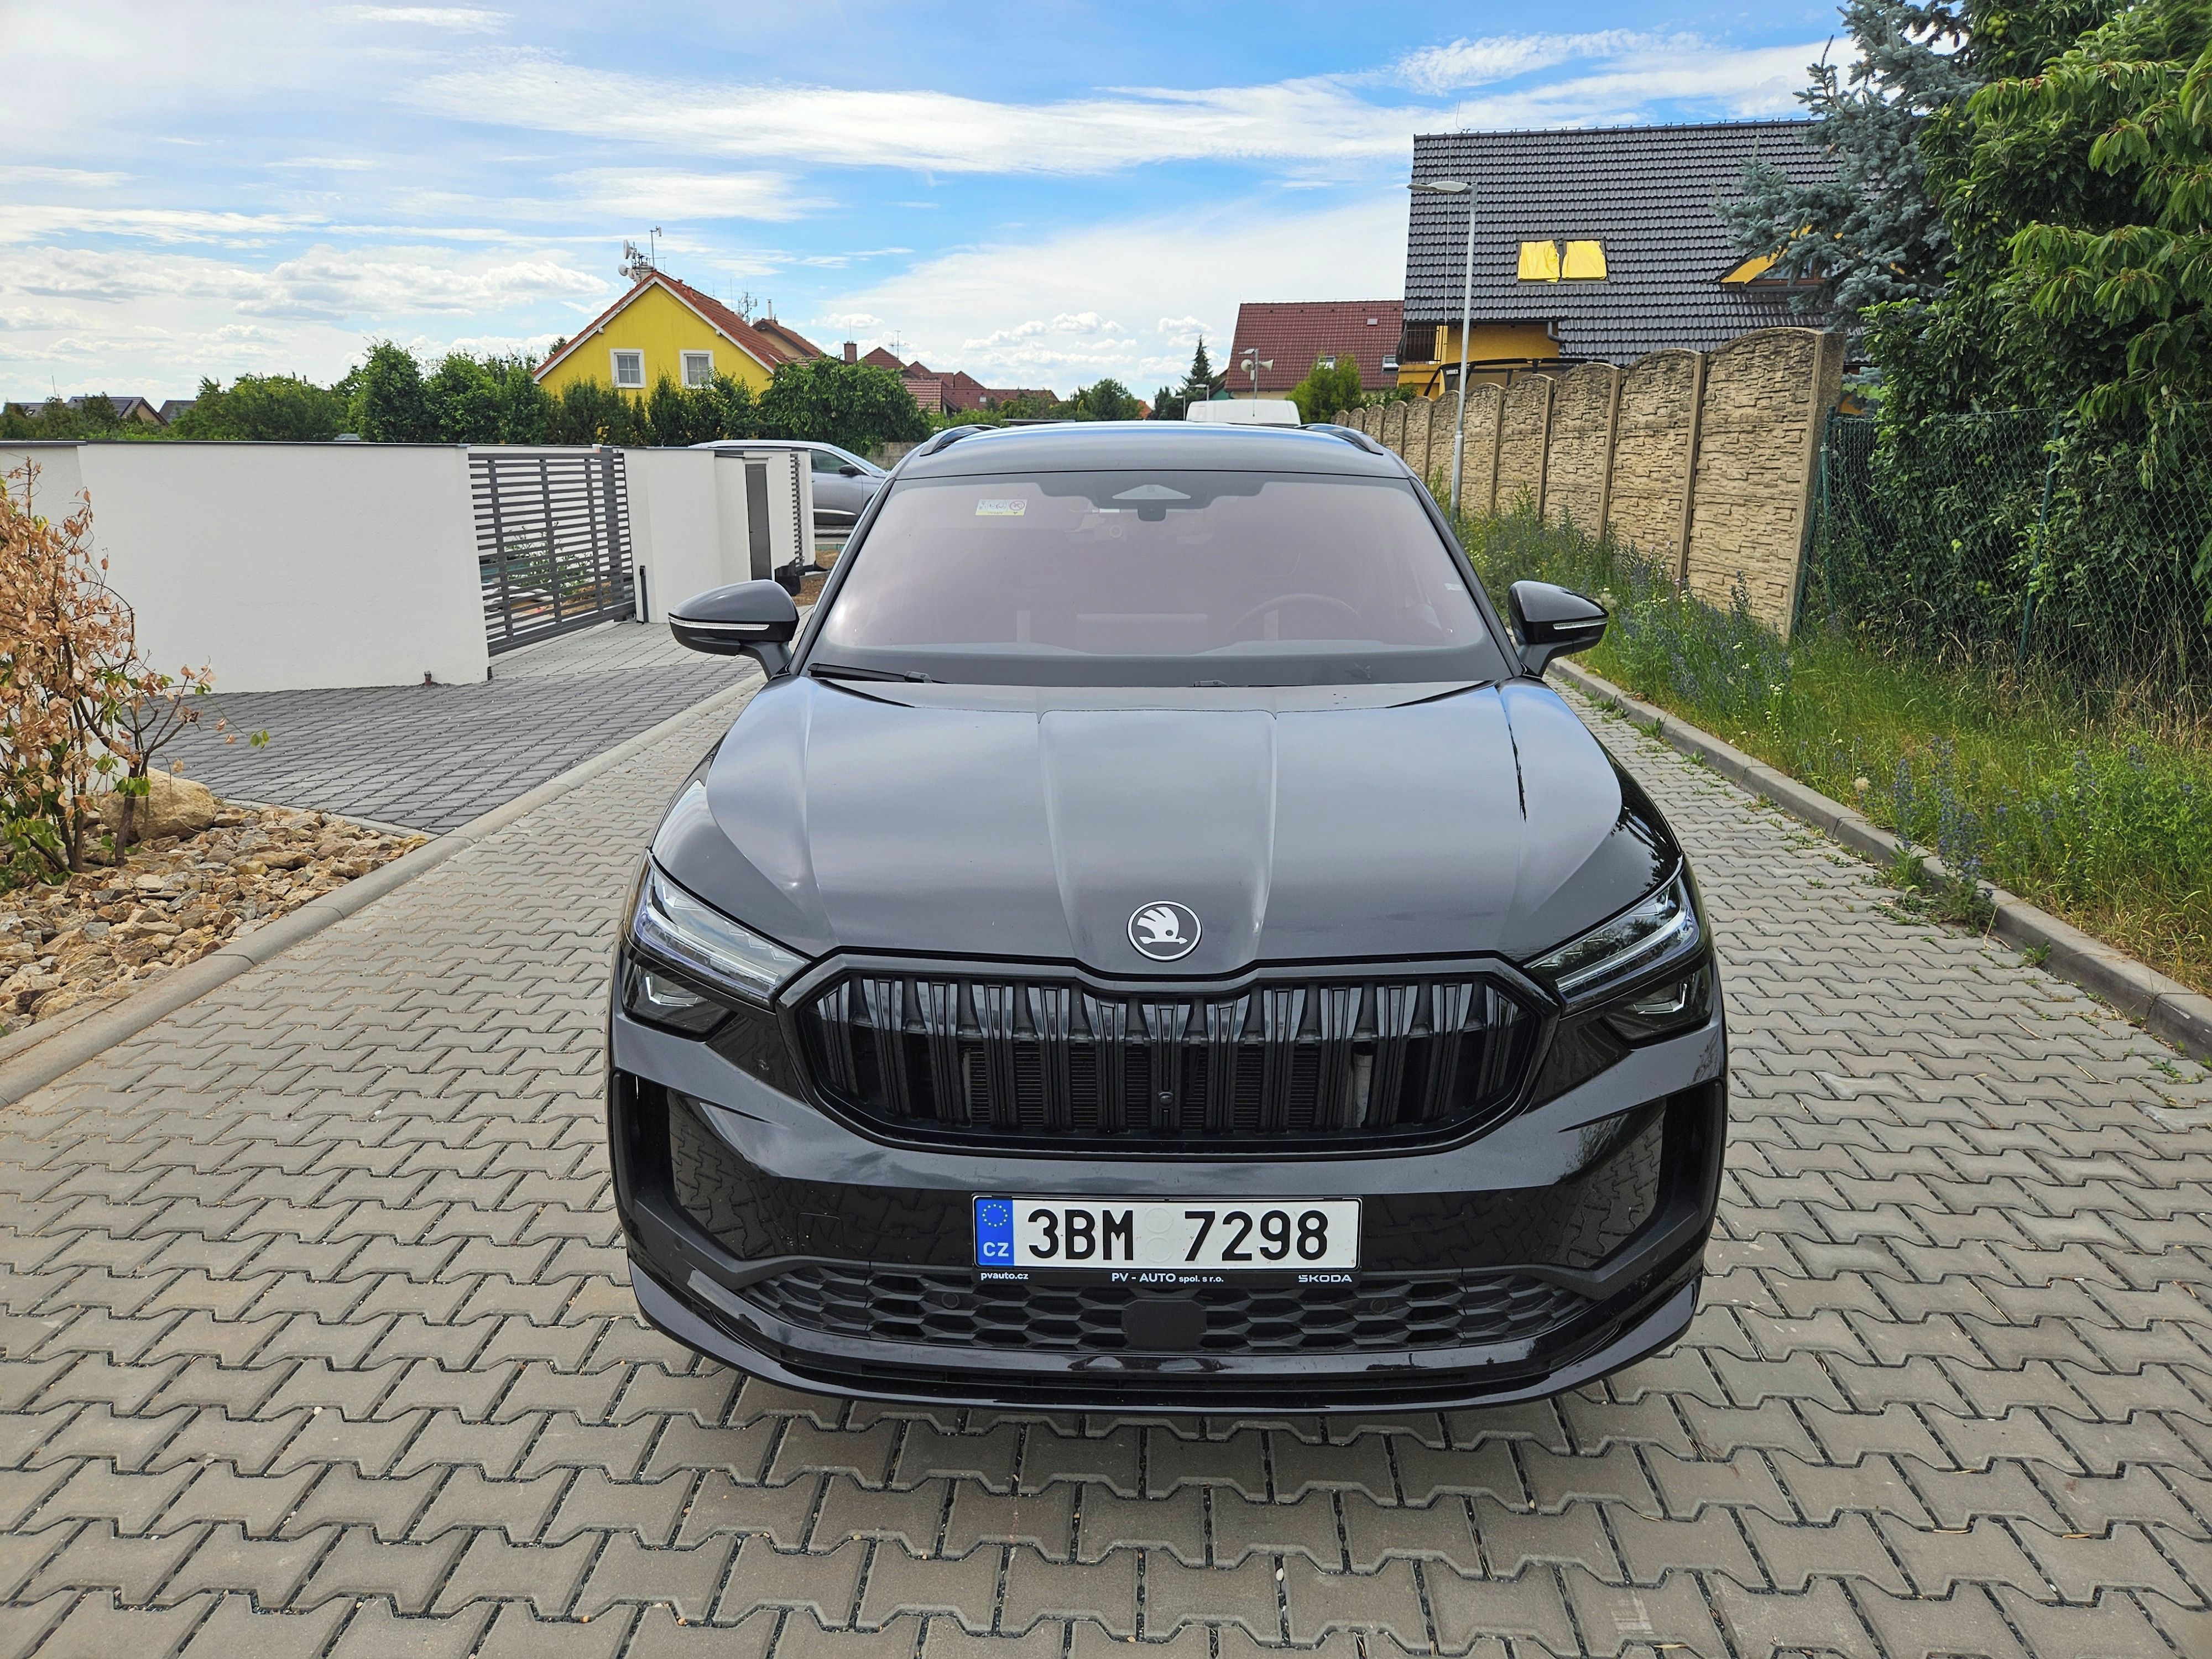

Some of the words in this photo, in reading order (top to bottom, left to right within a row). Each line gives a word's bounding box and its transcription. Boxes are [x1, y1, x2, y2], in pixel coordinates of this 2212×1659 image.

[1027, 1208, 1134, 1261] 3BM
[1184, 1209, 1329, 1262] 7298
[983, 1241, 1010, 1258] CZ
[980, 1271, 1029, 1281] pvauto.cz
[1111, 1272, 1129, 1282] PV
[1139, 1272, 1177, 1283] AUTO
[1178, 1274, 1201, 1284] spol.
